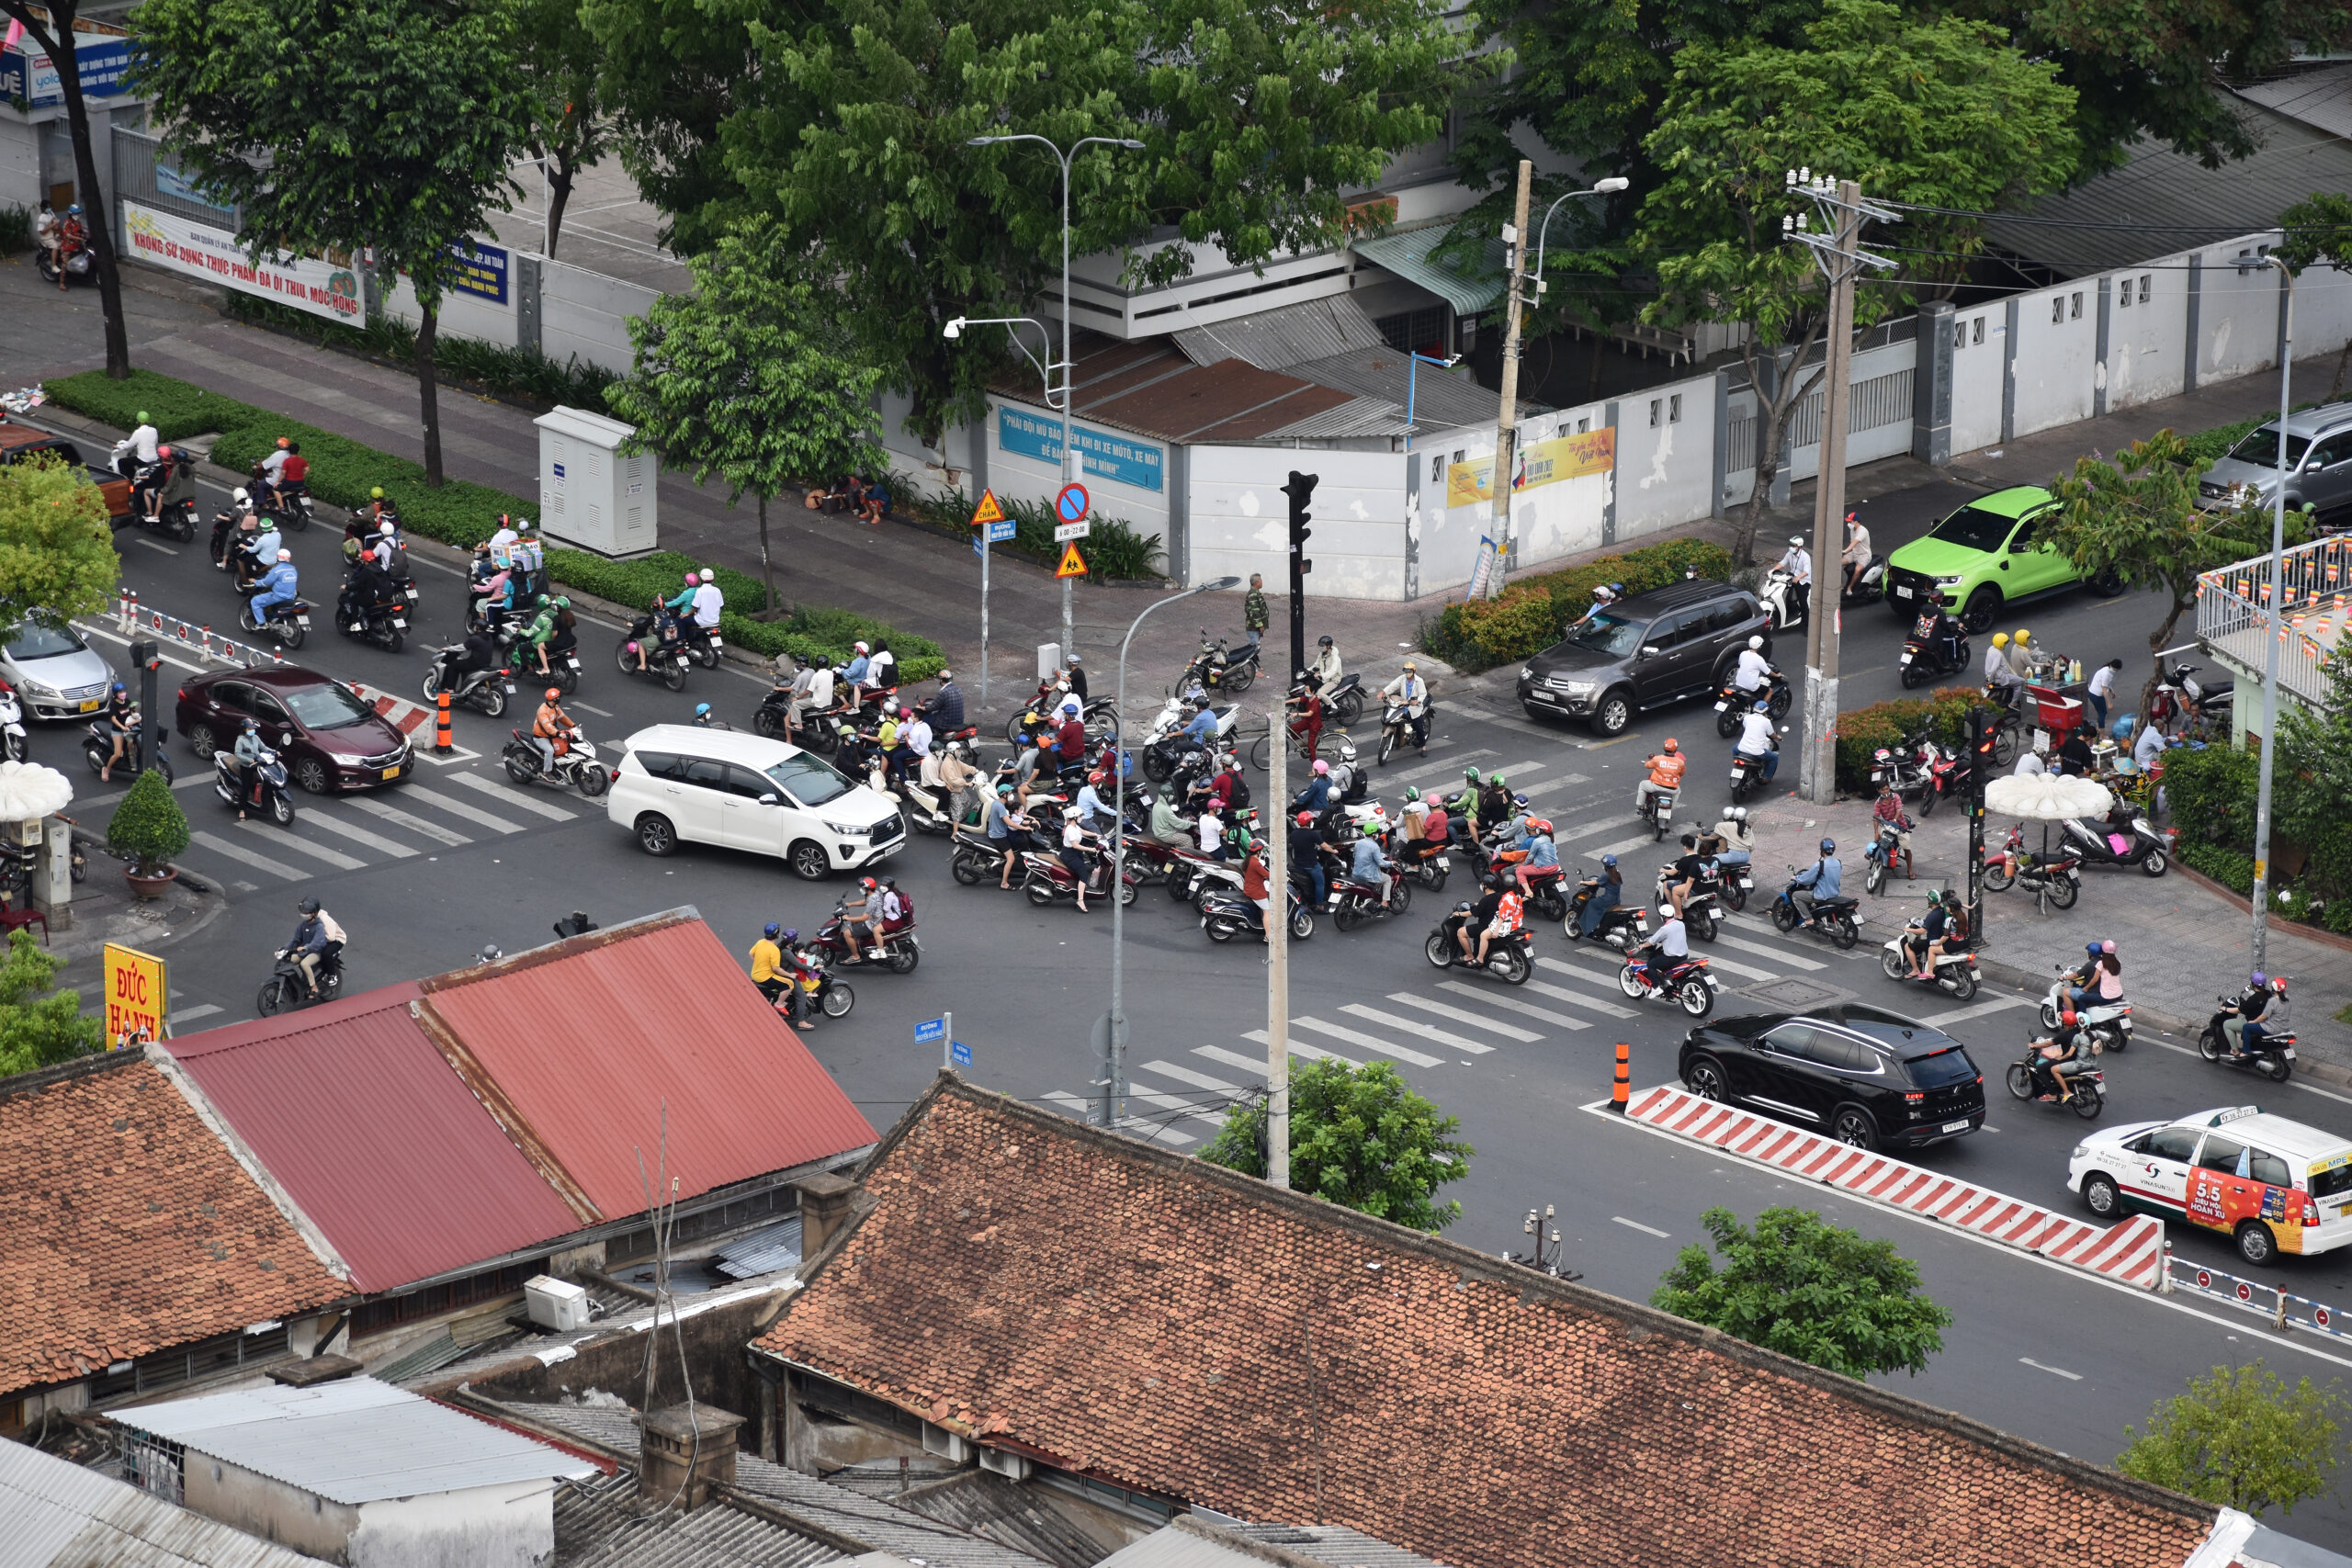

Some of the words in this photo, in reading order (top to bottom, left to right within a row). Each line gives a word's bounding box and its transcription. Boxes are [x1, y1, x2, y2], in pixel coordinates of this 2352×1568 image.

[190, 231, 200, 242] BAN
[206, 253, 230, 276] THỰC
[1023, 420, 1035, 435] ĐỘI
[1035, 423, 1047, 437] MŨ
[1048, 425, 1062, 441] BẢO
[1081, 434, 1093, 448] KHI
[1094, 438, 1102, 451] ĐI
[1102, 441, 1112, 455] XE
[1135, 450, 1144, 463] XE
[1145, 450, 1159, 467] MÁY
[117, 960, 147, 1006] ĐỨC
[2328, 1156, 2347, 1168] MPE
[2196, 1182, 2221, 1202] 5.5
[2190, 1202, 2213, 1216] HOÀN
[2214, 1210, 2225, 1220] XU
[2194, 1196, 2209, 1206] SIÊU
[2209, 1201, 2222, 1211] HỘI
